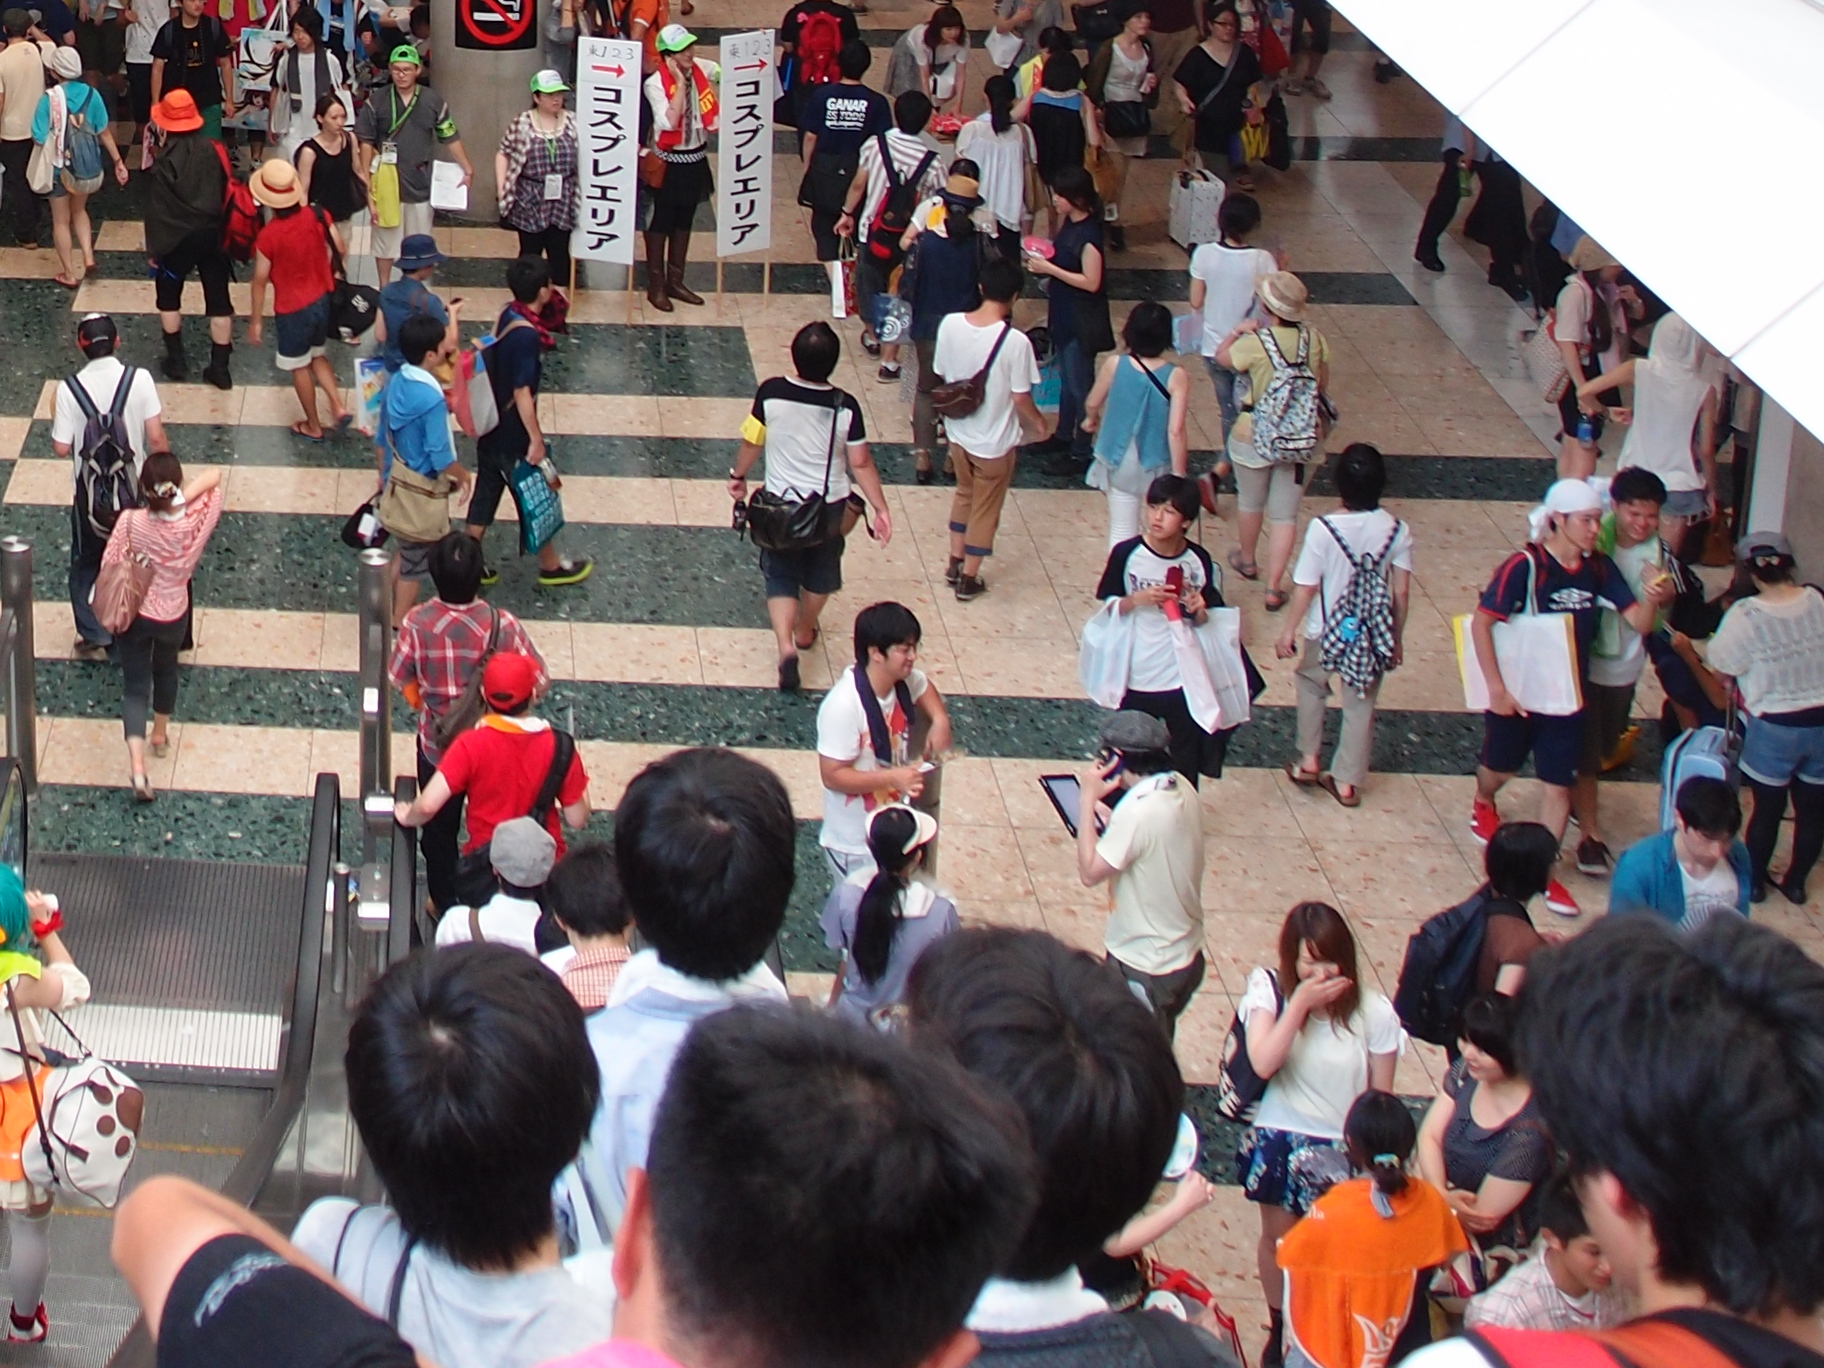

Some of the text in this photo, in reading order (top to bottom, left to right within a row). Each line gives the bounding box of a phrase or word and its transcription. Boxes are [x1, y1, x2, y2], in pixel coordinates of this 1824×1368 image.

[586, 85, 627, 251] コスプレエリア
[730, 79, 765, 246] コスプレエリア
[826, 97, 868, 112] GANAR
